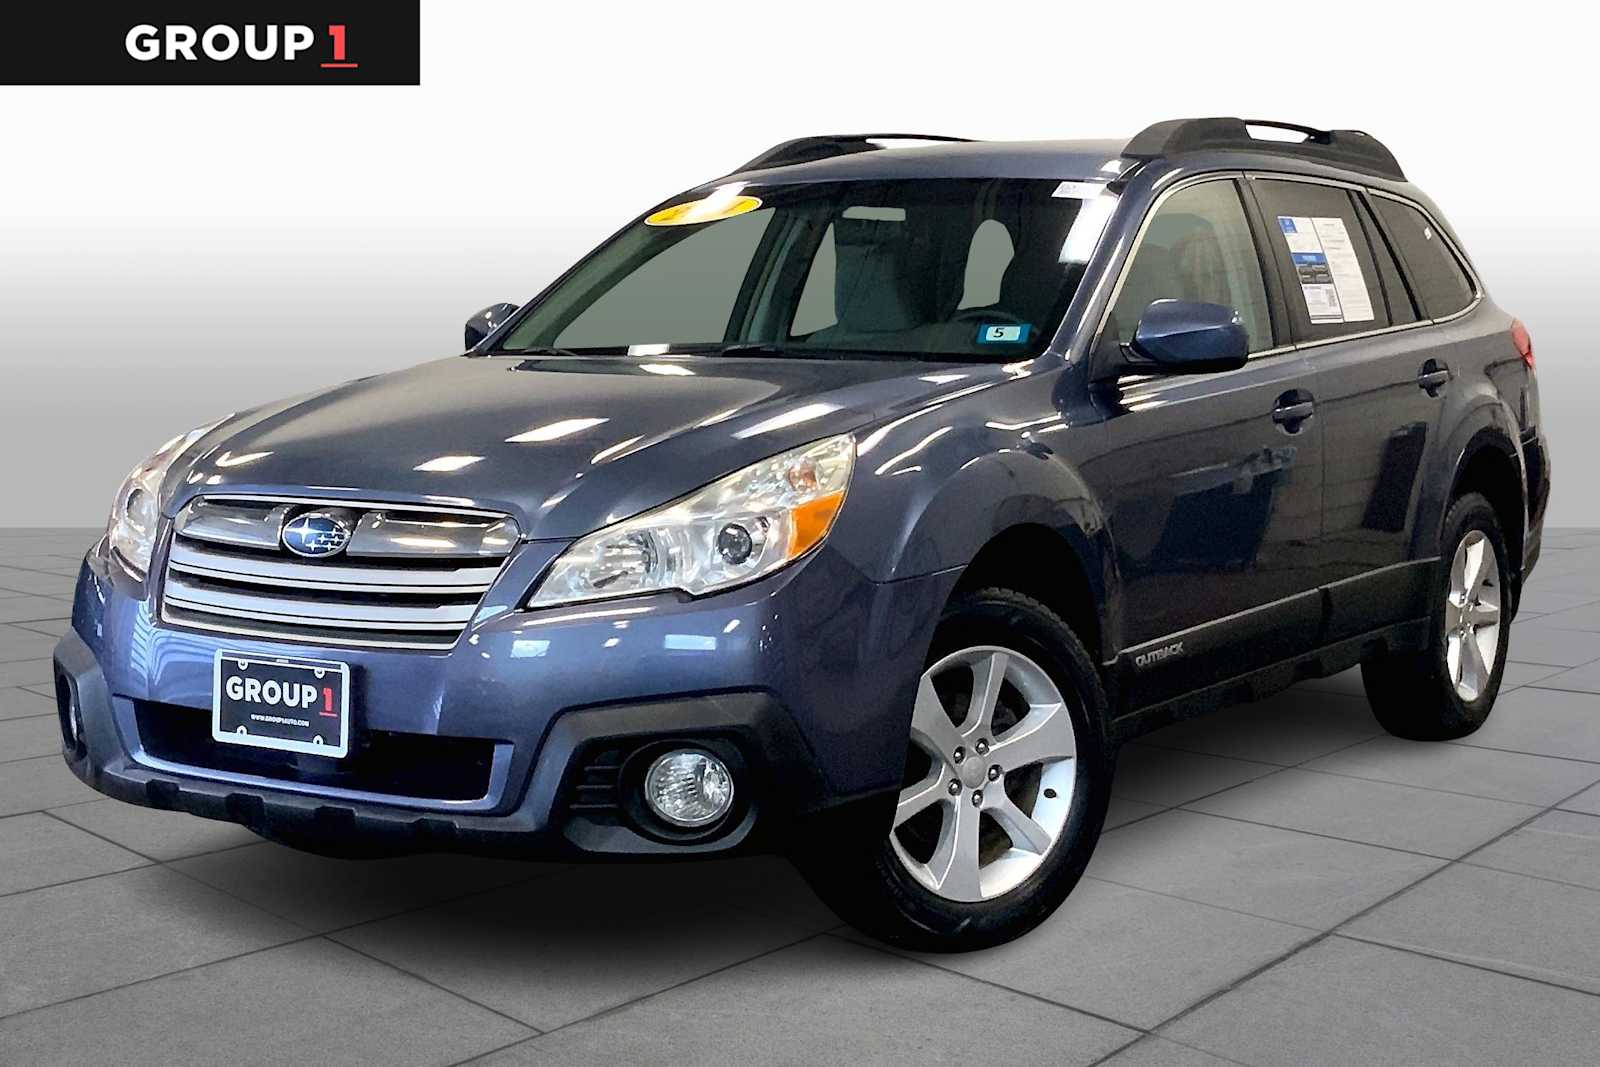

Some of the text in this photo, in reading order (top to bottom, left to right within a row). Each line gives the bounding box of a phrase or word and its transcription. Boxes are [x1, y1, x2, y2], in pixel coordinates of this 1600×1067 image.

[993, 327, 1004, 338] 5
[1135, 641, 1184, 667] OUTBACK
[226, 676, 338, 718] GROUP 1
